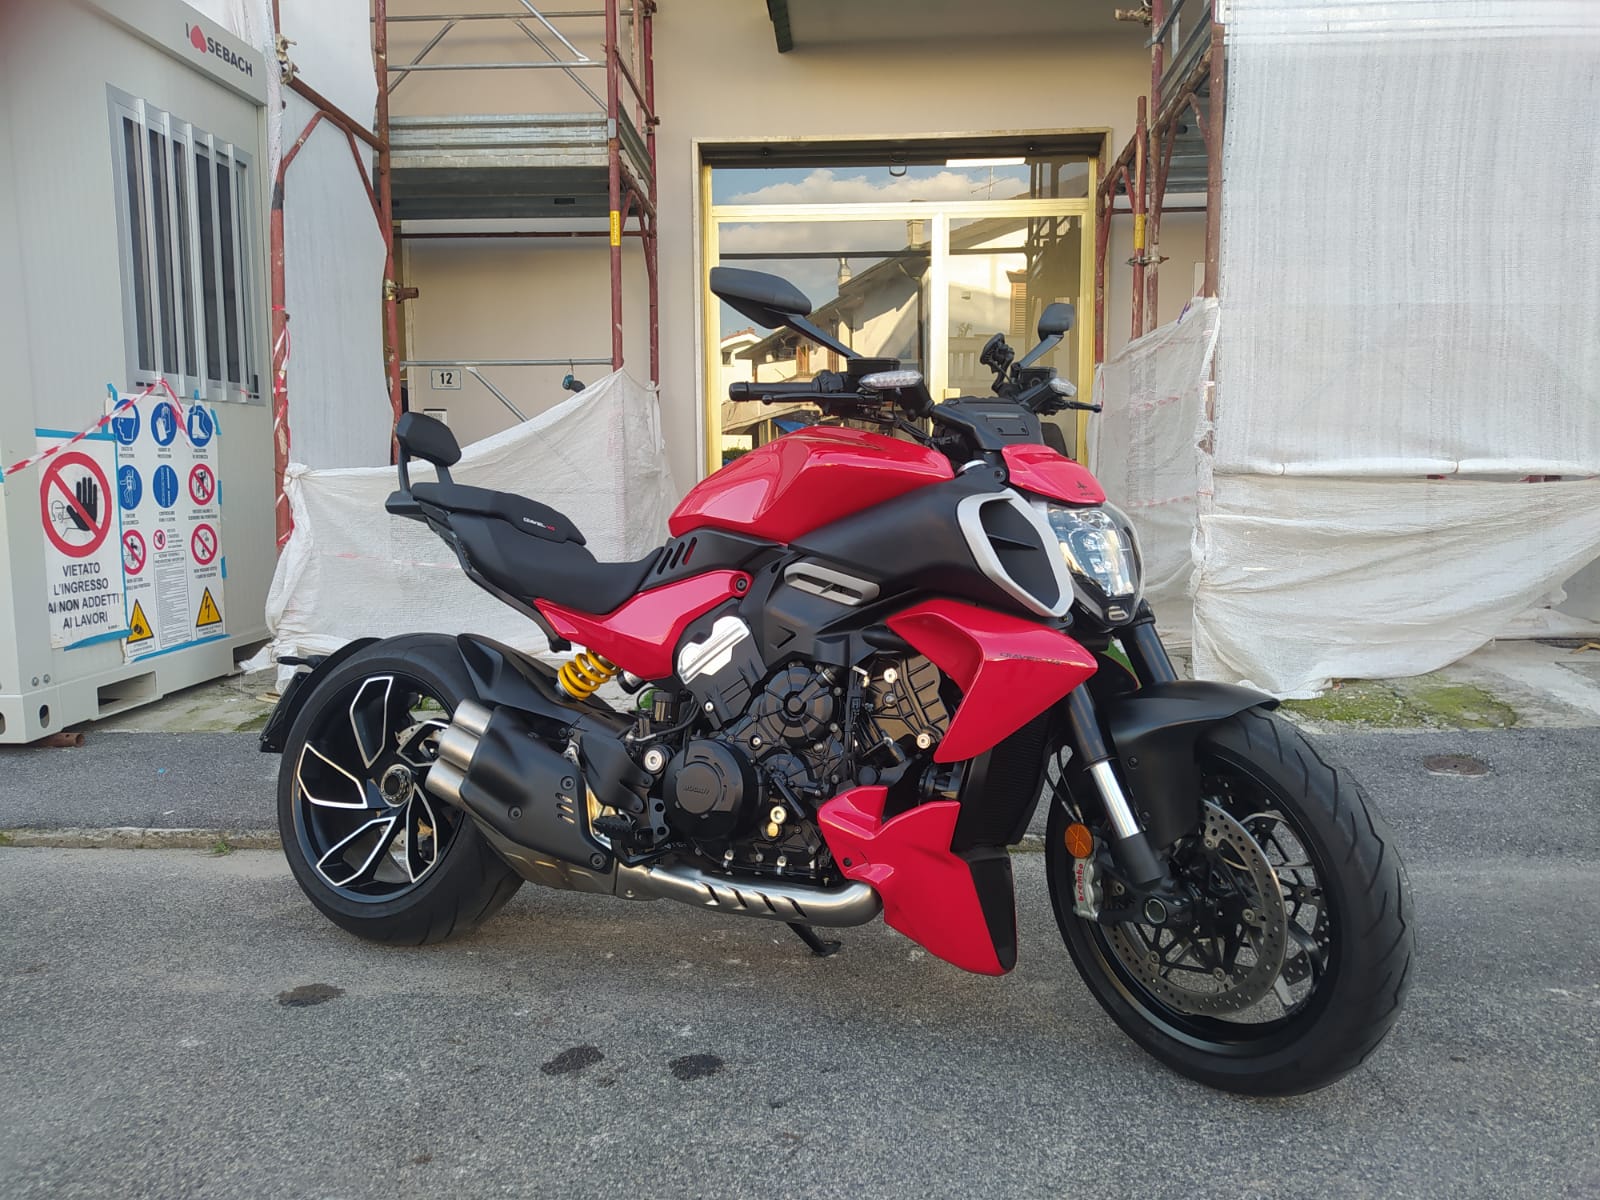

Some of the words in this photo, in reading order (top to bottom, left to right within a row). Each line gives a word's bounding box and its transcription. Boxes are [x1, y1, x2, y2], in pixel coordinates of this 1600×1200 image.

[207, 37, 253, 77] SEBACH
[440, 372, 453, 385] 12
[62, 562, 101, 577] VIETATO
[53, 577, 109, 596] L'INGRESSO
[48, 602, 57, 614] AI
[59, 599, 80, 613] NON
[82, 592, 120, 609] ADDETTI
[63, 616, 73, 630] AI
[74, 611, 109, 628] LAVORI
[1076, 863, 1085, 901] brembo
